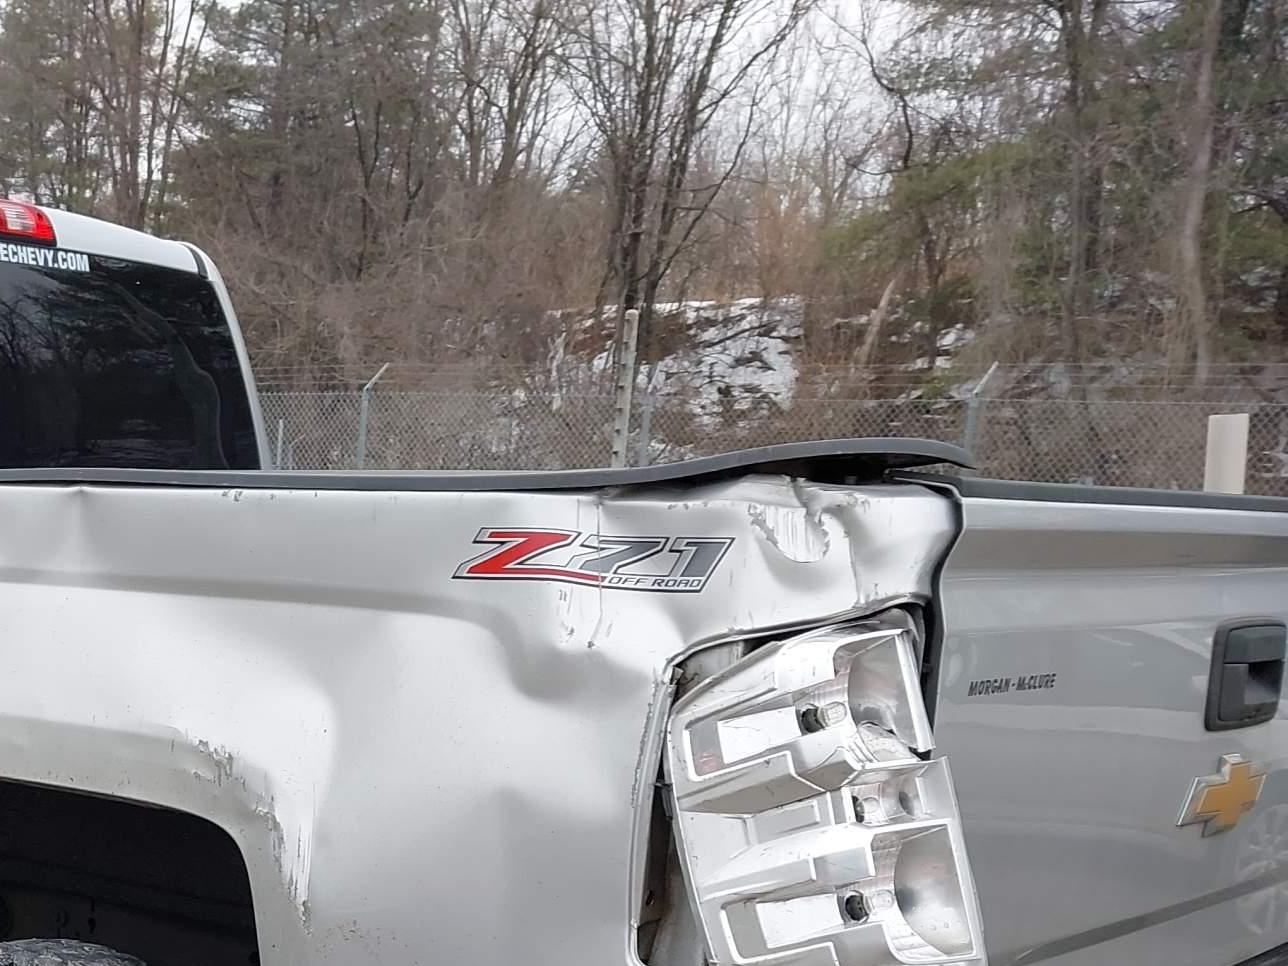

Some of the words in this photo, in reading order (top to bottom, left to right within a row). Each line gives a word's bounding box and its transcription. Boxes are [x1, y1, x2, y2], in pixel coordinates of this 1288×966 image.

[451, 527, 736, 592] Z71
[608, 576, 649, 586] OFF
[651, 577, 703, 588] ROAD
[968, 678, 1012, 697] MORGAN
